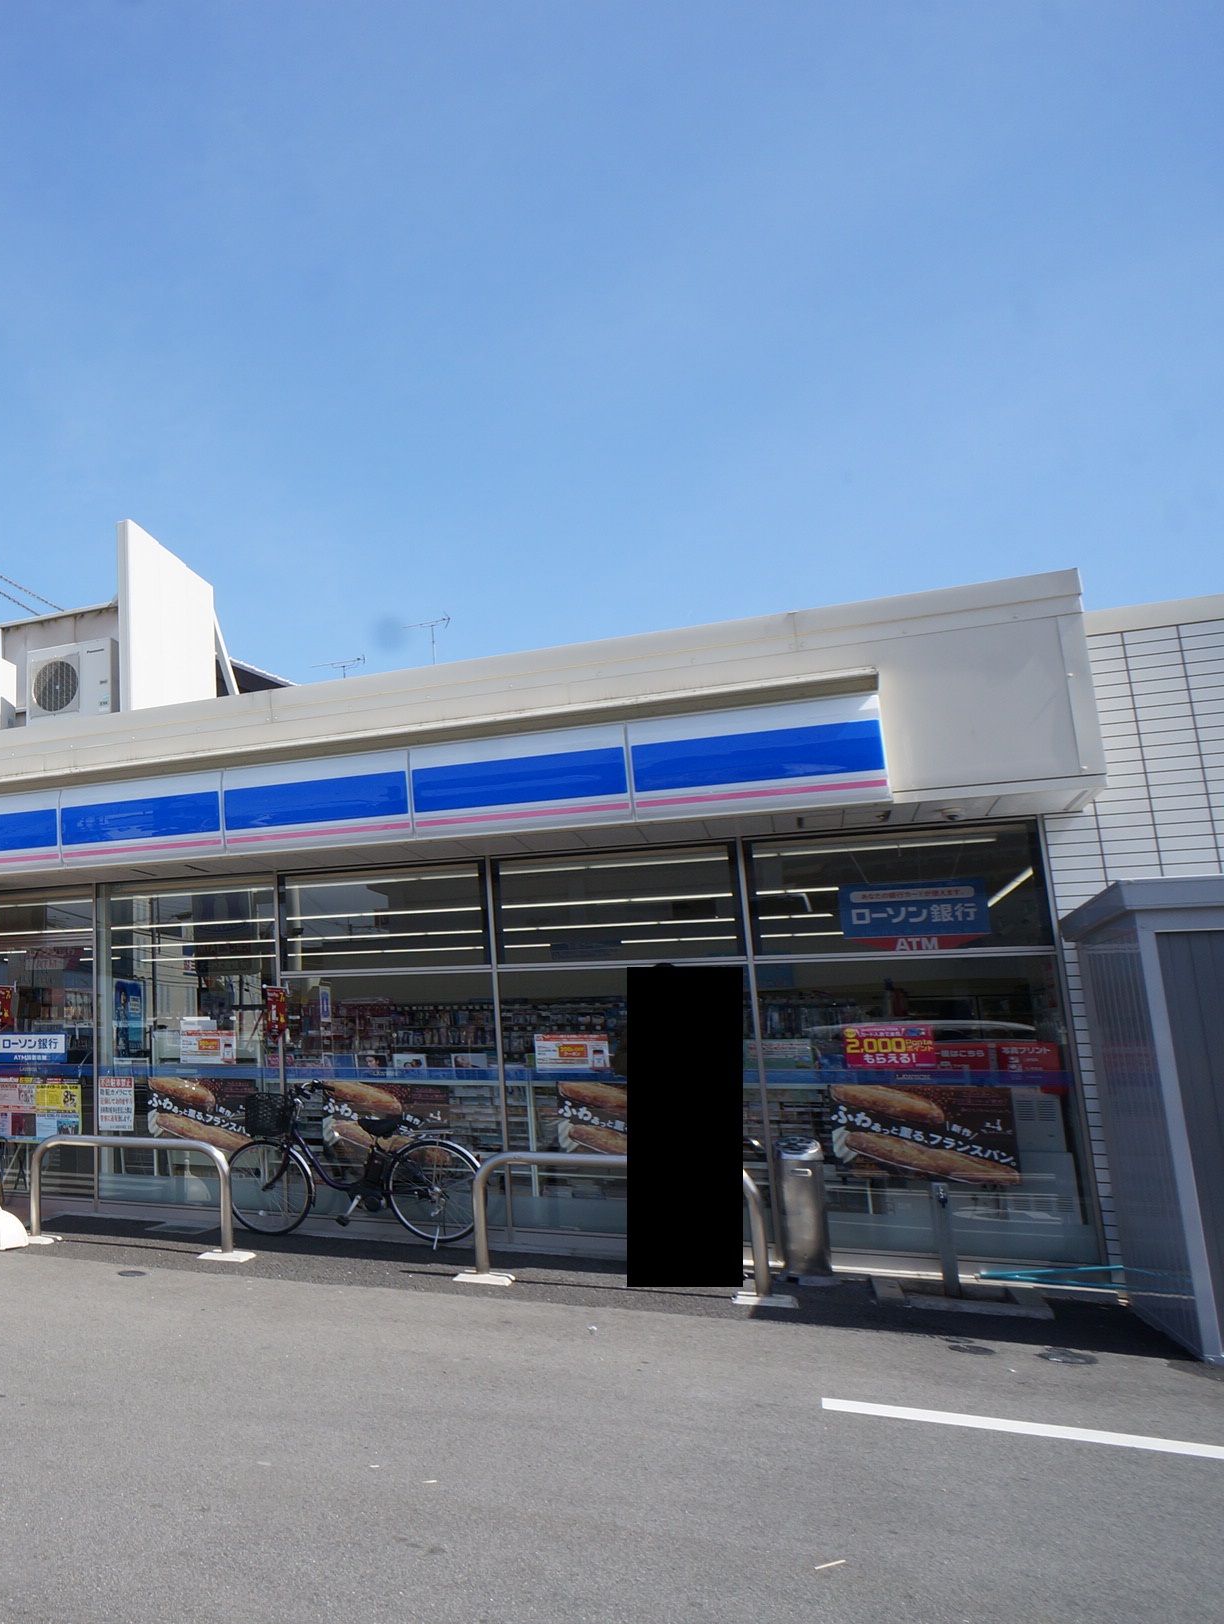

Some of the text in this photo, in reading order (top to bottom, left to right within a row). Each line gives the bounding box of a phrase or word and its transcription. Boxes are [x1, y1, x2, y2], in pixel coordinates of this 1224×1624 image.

[851, 903, 978, 925] ローソン銀行
[895, 937, 939, 951] ATM
[2, 1038, 58, 1050] ローソン銀行
[846, 1037, 906, 1053] 2,000
[830, 1105, 1017, 1167] ふわぁっと薫る、フランスパン。
[951, 1123, 972, 1138] 新作
